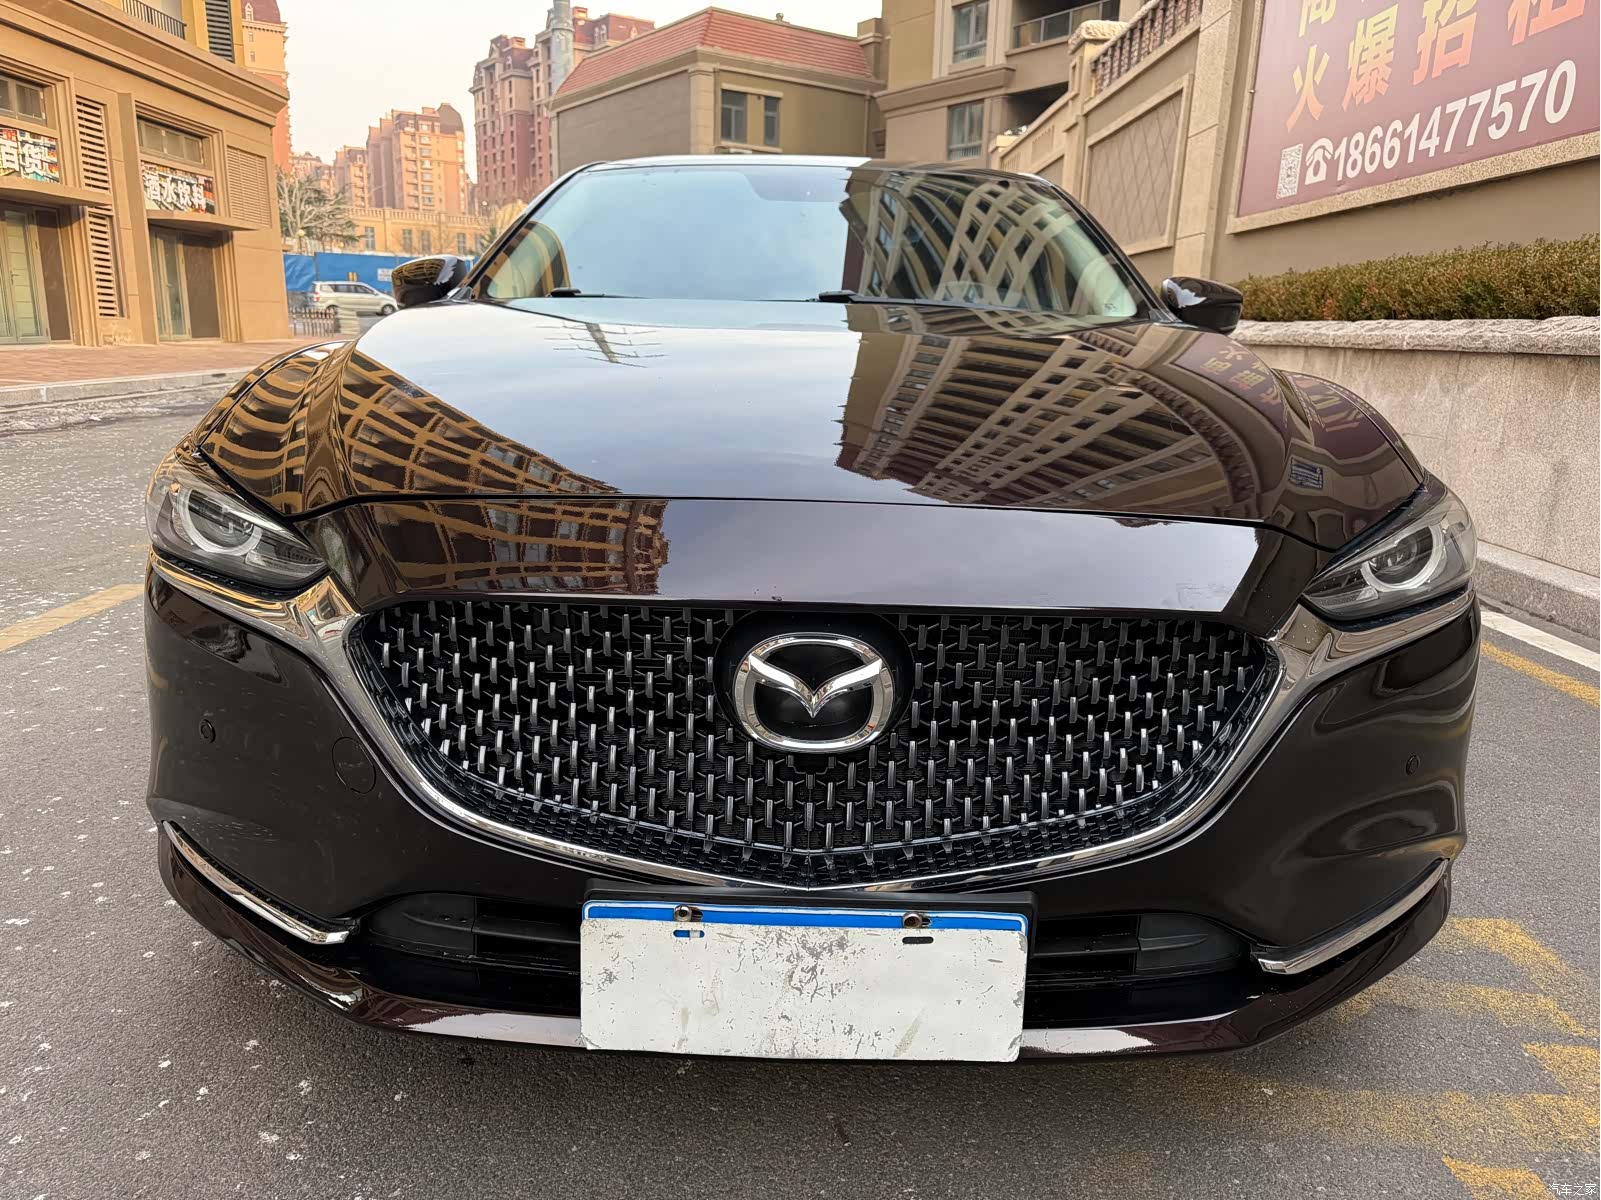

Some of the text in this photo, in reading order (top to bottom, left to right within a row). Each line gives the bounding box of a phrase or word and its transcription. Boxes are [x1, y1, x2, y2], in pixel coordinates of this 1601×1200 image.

[1333, 59, 1577, 181] 18661477570
[0, 139, 48, 174] 百货
[143, 174, 207, 210] 酒水饮料
